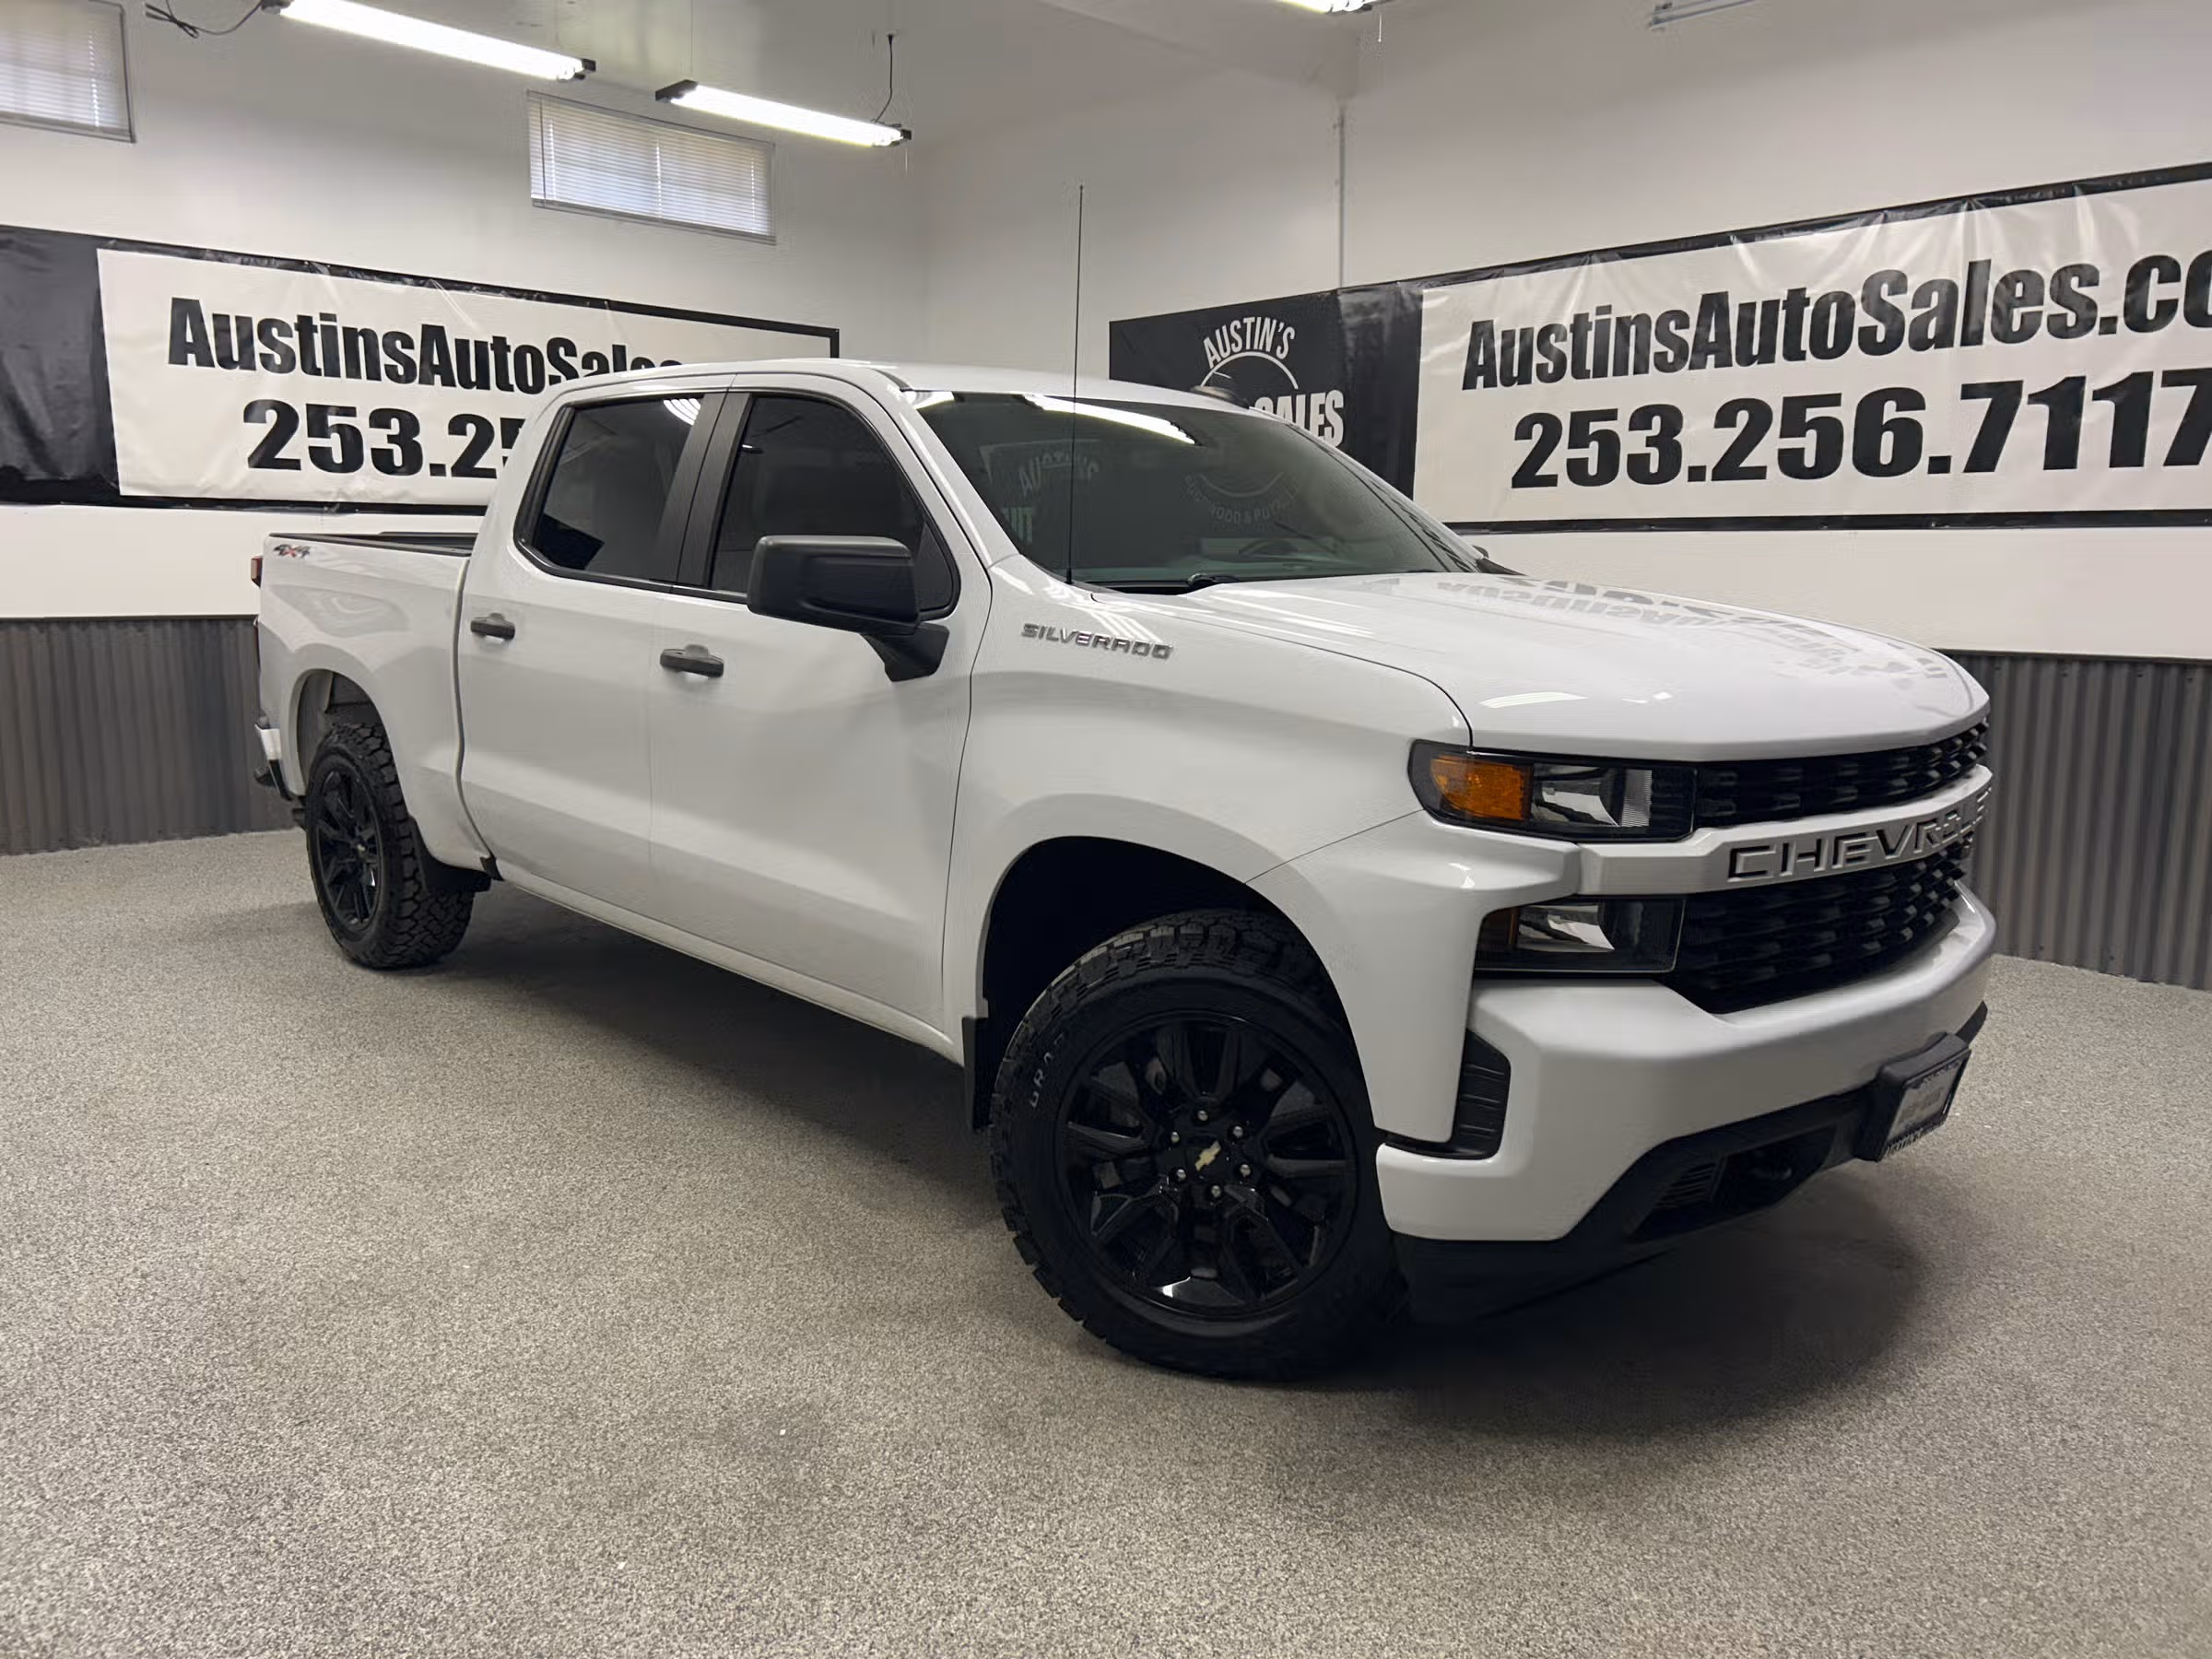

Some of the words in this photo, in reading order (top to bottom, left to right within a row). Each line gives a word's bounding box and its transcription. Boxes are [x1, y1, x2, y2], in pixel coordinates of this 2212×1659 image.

[1203, 316, 1295, 369] AUSTIN'S
[1511, 368, 2212, 488] 253.256.7117
[1021, 623, 1172, 660] SILVERADO
